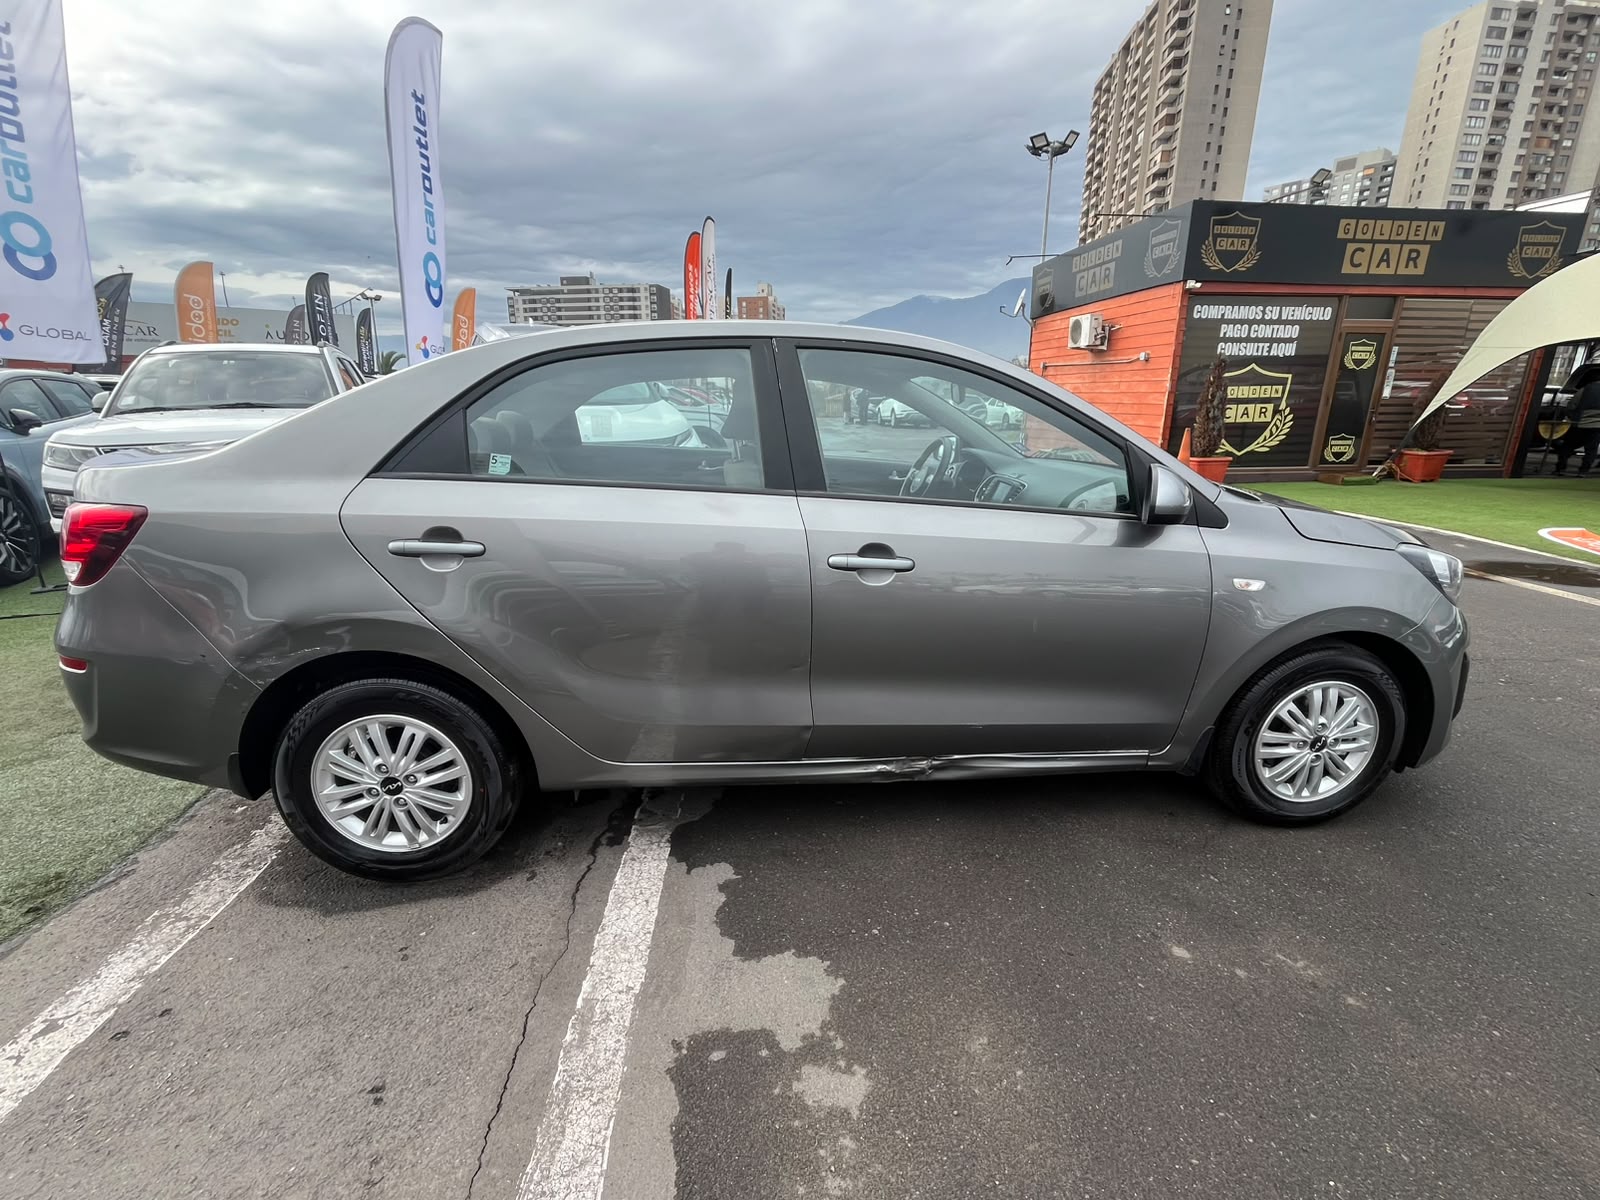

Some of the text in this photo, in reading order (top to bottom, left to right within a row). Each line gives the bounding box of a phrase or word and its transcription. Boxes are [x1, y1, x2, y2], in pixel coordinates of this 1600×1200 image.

[410, 88, 437, 247] caroutlet
[1340, 220, 1443, 239] GOLDEN
[1217, 238, 1248, 249] CAR
[1346, 245, 1425, 271] CAR
[1077, 264, 1113, 295] CAR
[1193, 304, 1333, 321] COMPRAMOS SU VEHÍCULO
[18, 324, 92, 341] GLOBAL
[1219, 324, 1300, 339] PAGO CONTADO
[1217, 341, 1298, 357] CONSULTE AQUÍ
[1227, 386, 1282, 398] OLDEN
[1225, 404, 1272, 421] CAR
[491, 455, 498, 465] 5
